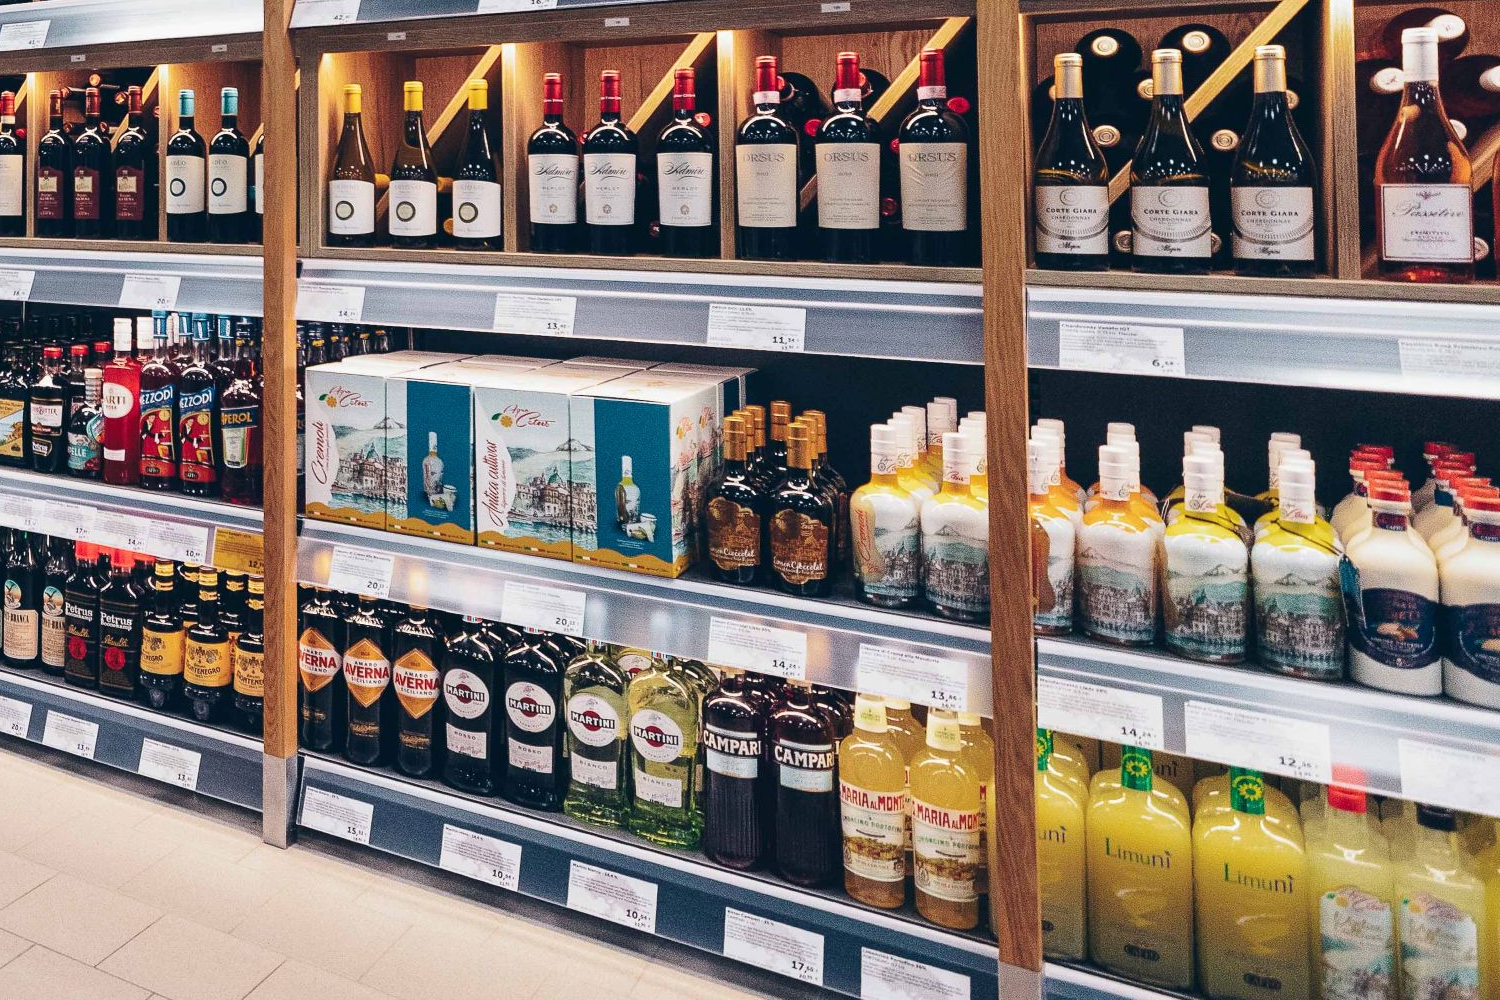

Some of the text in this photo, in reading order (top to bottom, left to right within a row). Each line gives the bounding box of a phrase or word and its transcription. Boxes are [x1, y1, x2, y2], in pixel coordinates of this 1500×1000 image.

[140, 386, 173, 405] EZZODÌ
[180, 390, 212, 409] EZZODÌ
[481, 439, 503, 527] Antica cultivar
[65, 601, 93, 617] Petrus
[100, 611, 132, 626] Petrus
[300, 652, 337, 669] VERNA
[345, 665, 389, 679] AVERNA
[351, 677, 382, 685] SICILIANO
[395, 672, 440, 690] AVERNA
[446, 684, 485, 702] MARTINI
[509, 698, 551, 714] MARTINI
[571, 711, 615, 729] MARTINI
[454, 731, 476, 740] ROSSO
[634, 726, 678, 745] MARTINI
[518, 745, 542, 754] ROSSO
[774, 746, 834, 769] CAMPAR
[580, 760, 608, 770] BIANCO
[642, 776, 672, 787] BIANCO
[841, 786, 869, 809] MARIA
[917, 806, 951, 828] MARIA
[959, 814, 980, 832] MON
